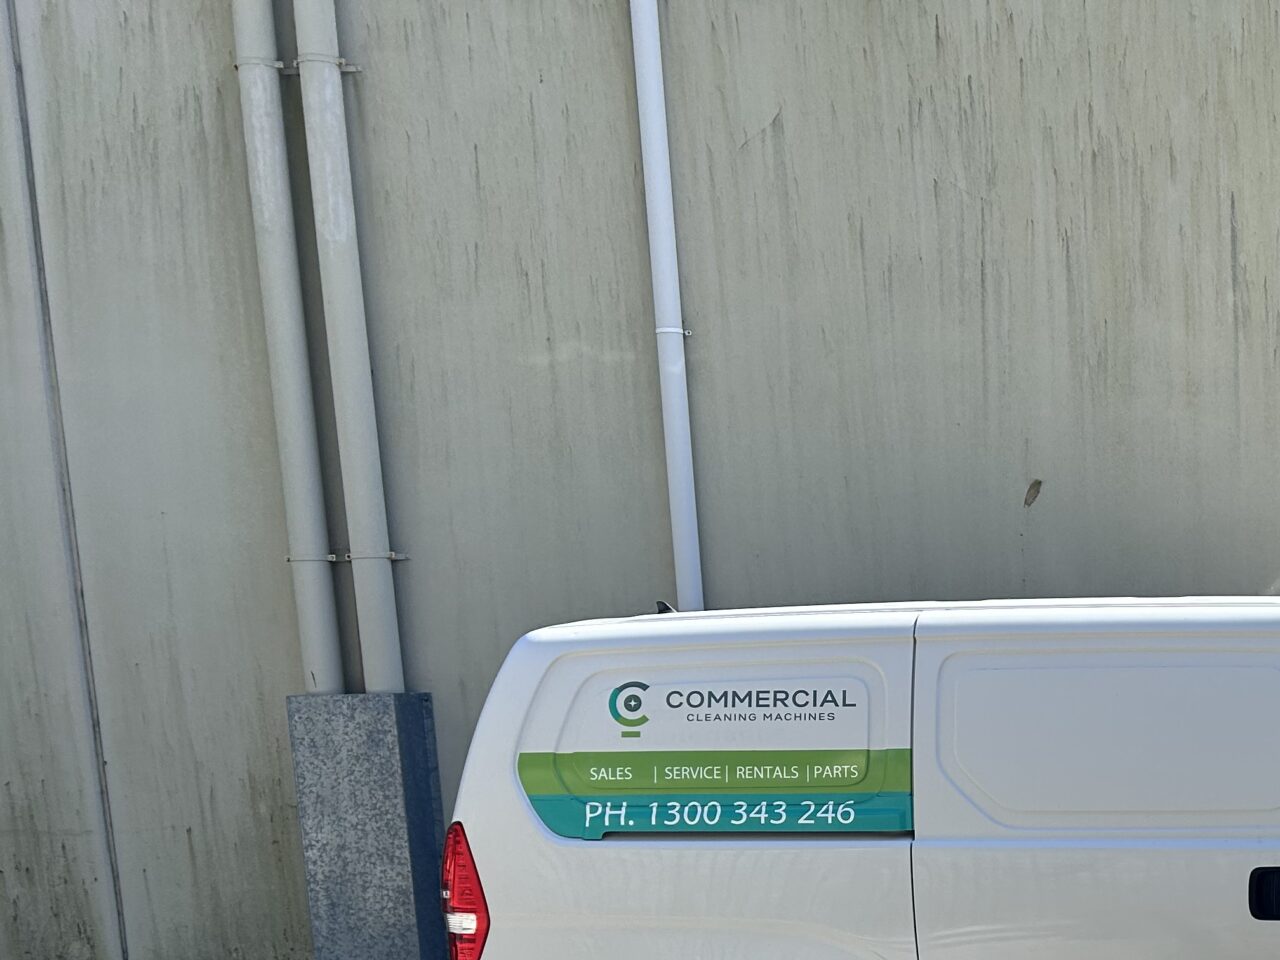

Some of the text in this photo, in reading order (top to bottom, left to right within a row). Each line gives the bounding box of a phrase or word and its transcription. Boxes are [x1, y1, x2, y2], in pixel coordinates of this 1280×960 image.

[666, 689, 857, 709] COMMERCIAL
[686, 712, 835, 722] CLEANING MACHINES
[590, 765, 859, 781] SALES SERVICE RENTALS PARTS
[586, 801, 854, 826] PH. 1300 343 246
